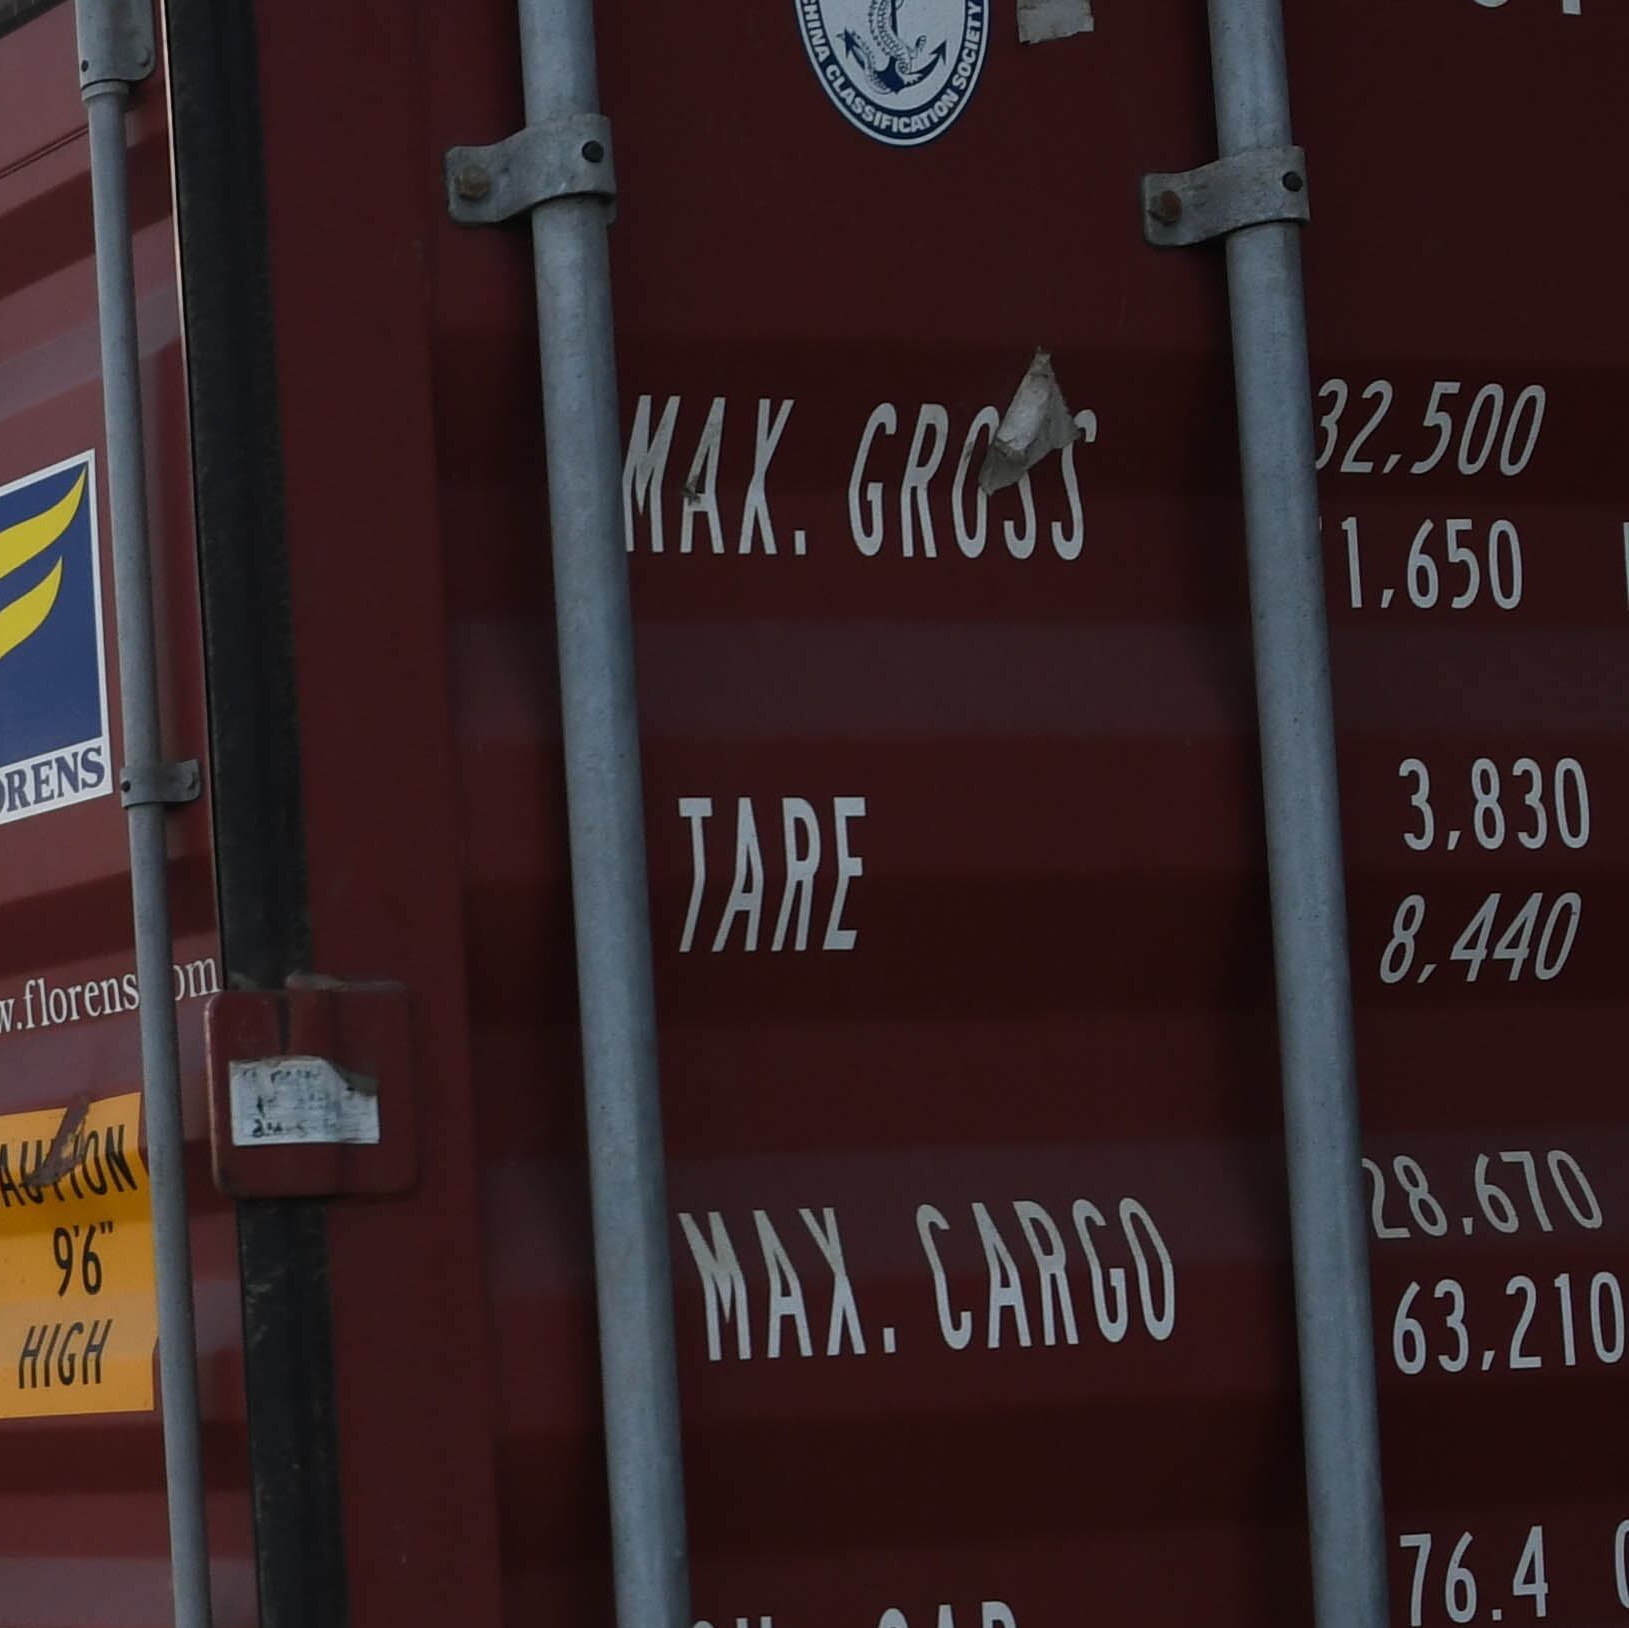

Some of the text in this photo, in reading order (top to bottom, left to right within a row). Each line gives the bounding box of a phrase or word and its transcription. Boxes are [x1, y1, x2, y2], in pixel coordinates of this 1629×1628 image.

[825, 63, 960, 134] CLASSIFICATION
[951, 0, 985, 95] SOCIETY
[622, 394, 807, 555] MAX.
[1314, 378, 1546, 476] 32,500
[1319, 516, 1523, 610] 1,650
[1398, 757, 1590, 851] 3,830
[678, 796, 867, 953] TARE
[1379, 891, 1582, 985] 8,440
[678, 1197, 1176, 1361] MAX. CARGO
[1391, 1271, 1626, 1375] 63,210
[17, 1318, 114, 1390] HIGH
[1399, 1525, 1549, 1628] 76.4
